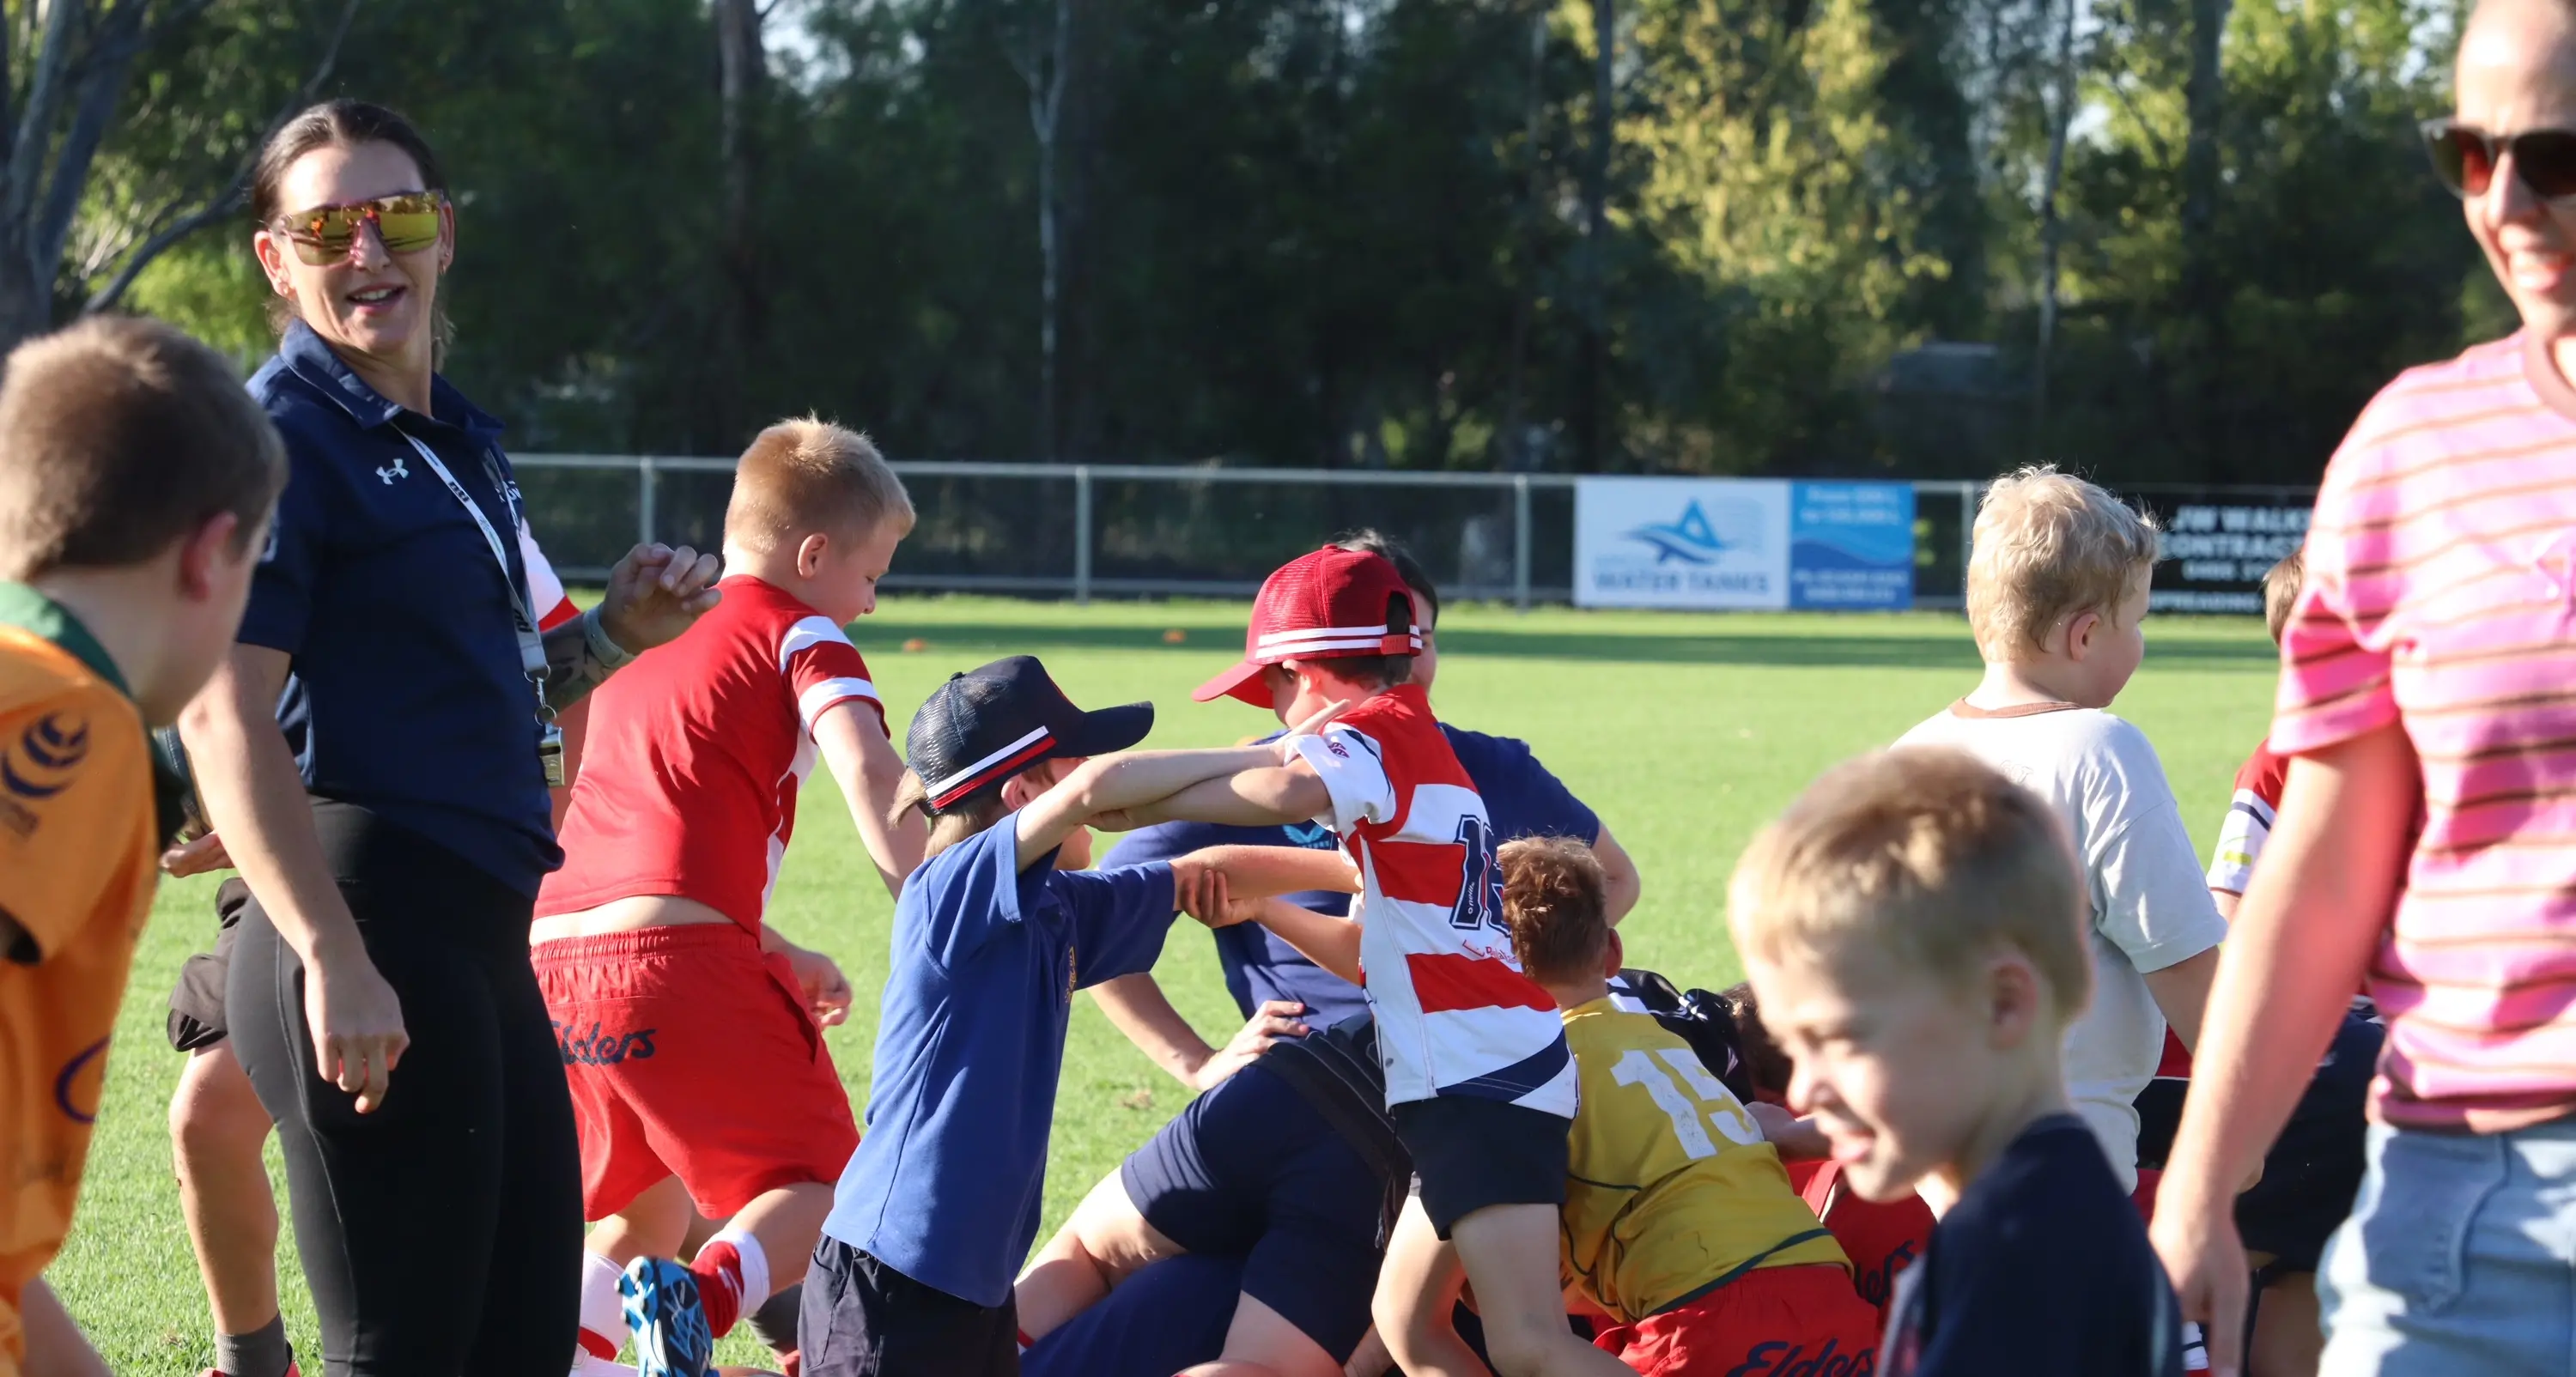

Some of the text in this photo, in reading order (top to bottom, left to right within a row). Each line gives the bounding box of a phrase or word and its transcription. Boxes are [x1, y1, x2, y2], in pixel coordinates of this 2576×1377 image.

[1593, 569, 1680, 593] WATER
[1687, 571, 1770, 595] TANKS
[1609, 1047, 1765, 1159] 15
